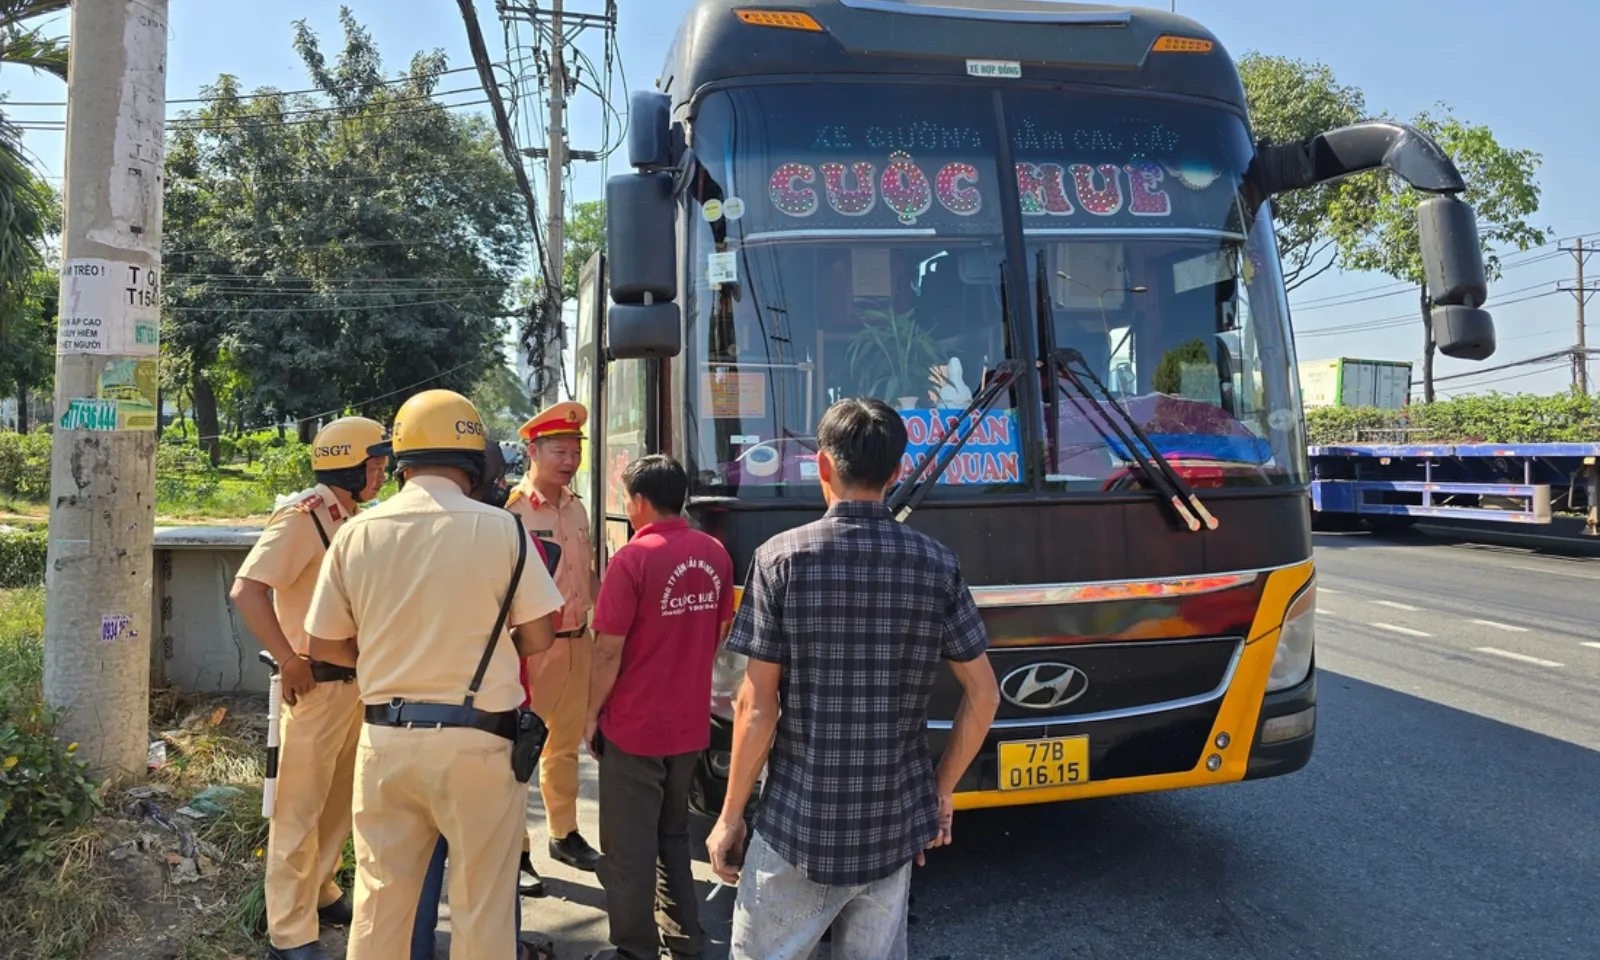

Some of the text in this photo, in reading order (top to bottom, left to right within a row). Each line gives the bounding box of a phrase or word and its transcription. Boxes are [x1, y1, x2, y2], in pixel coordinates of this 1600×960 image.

[82, 318, 102, 326] CAO
[455, 420, 484, 435] CSG
[314, 444, 351, 457] CSGT
[1026, 741, 1064, 763] 77B
[1010, 762, 1080, 787] 016.15
